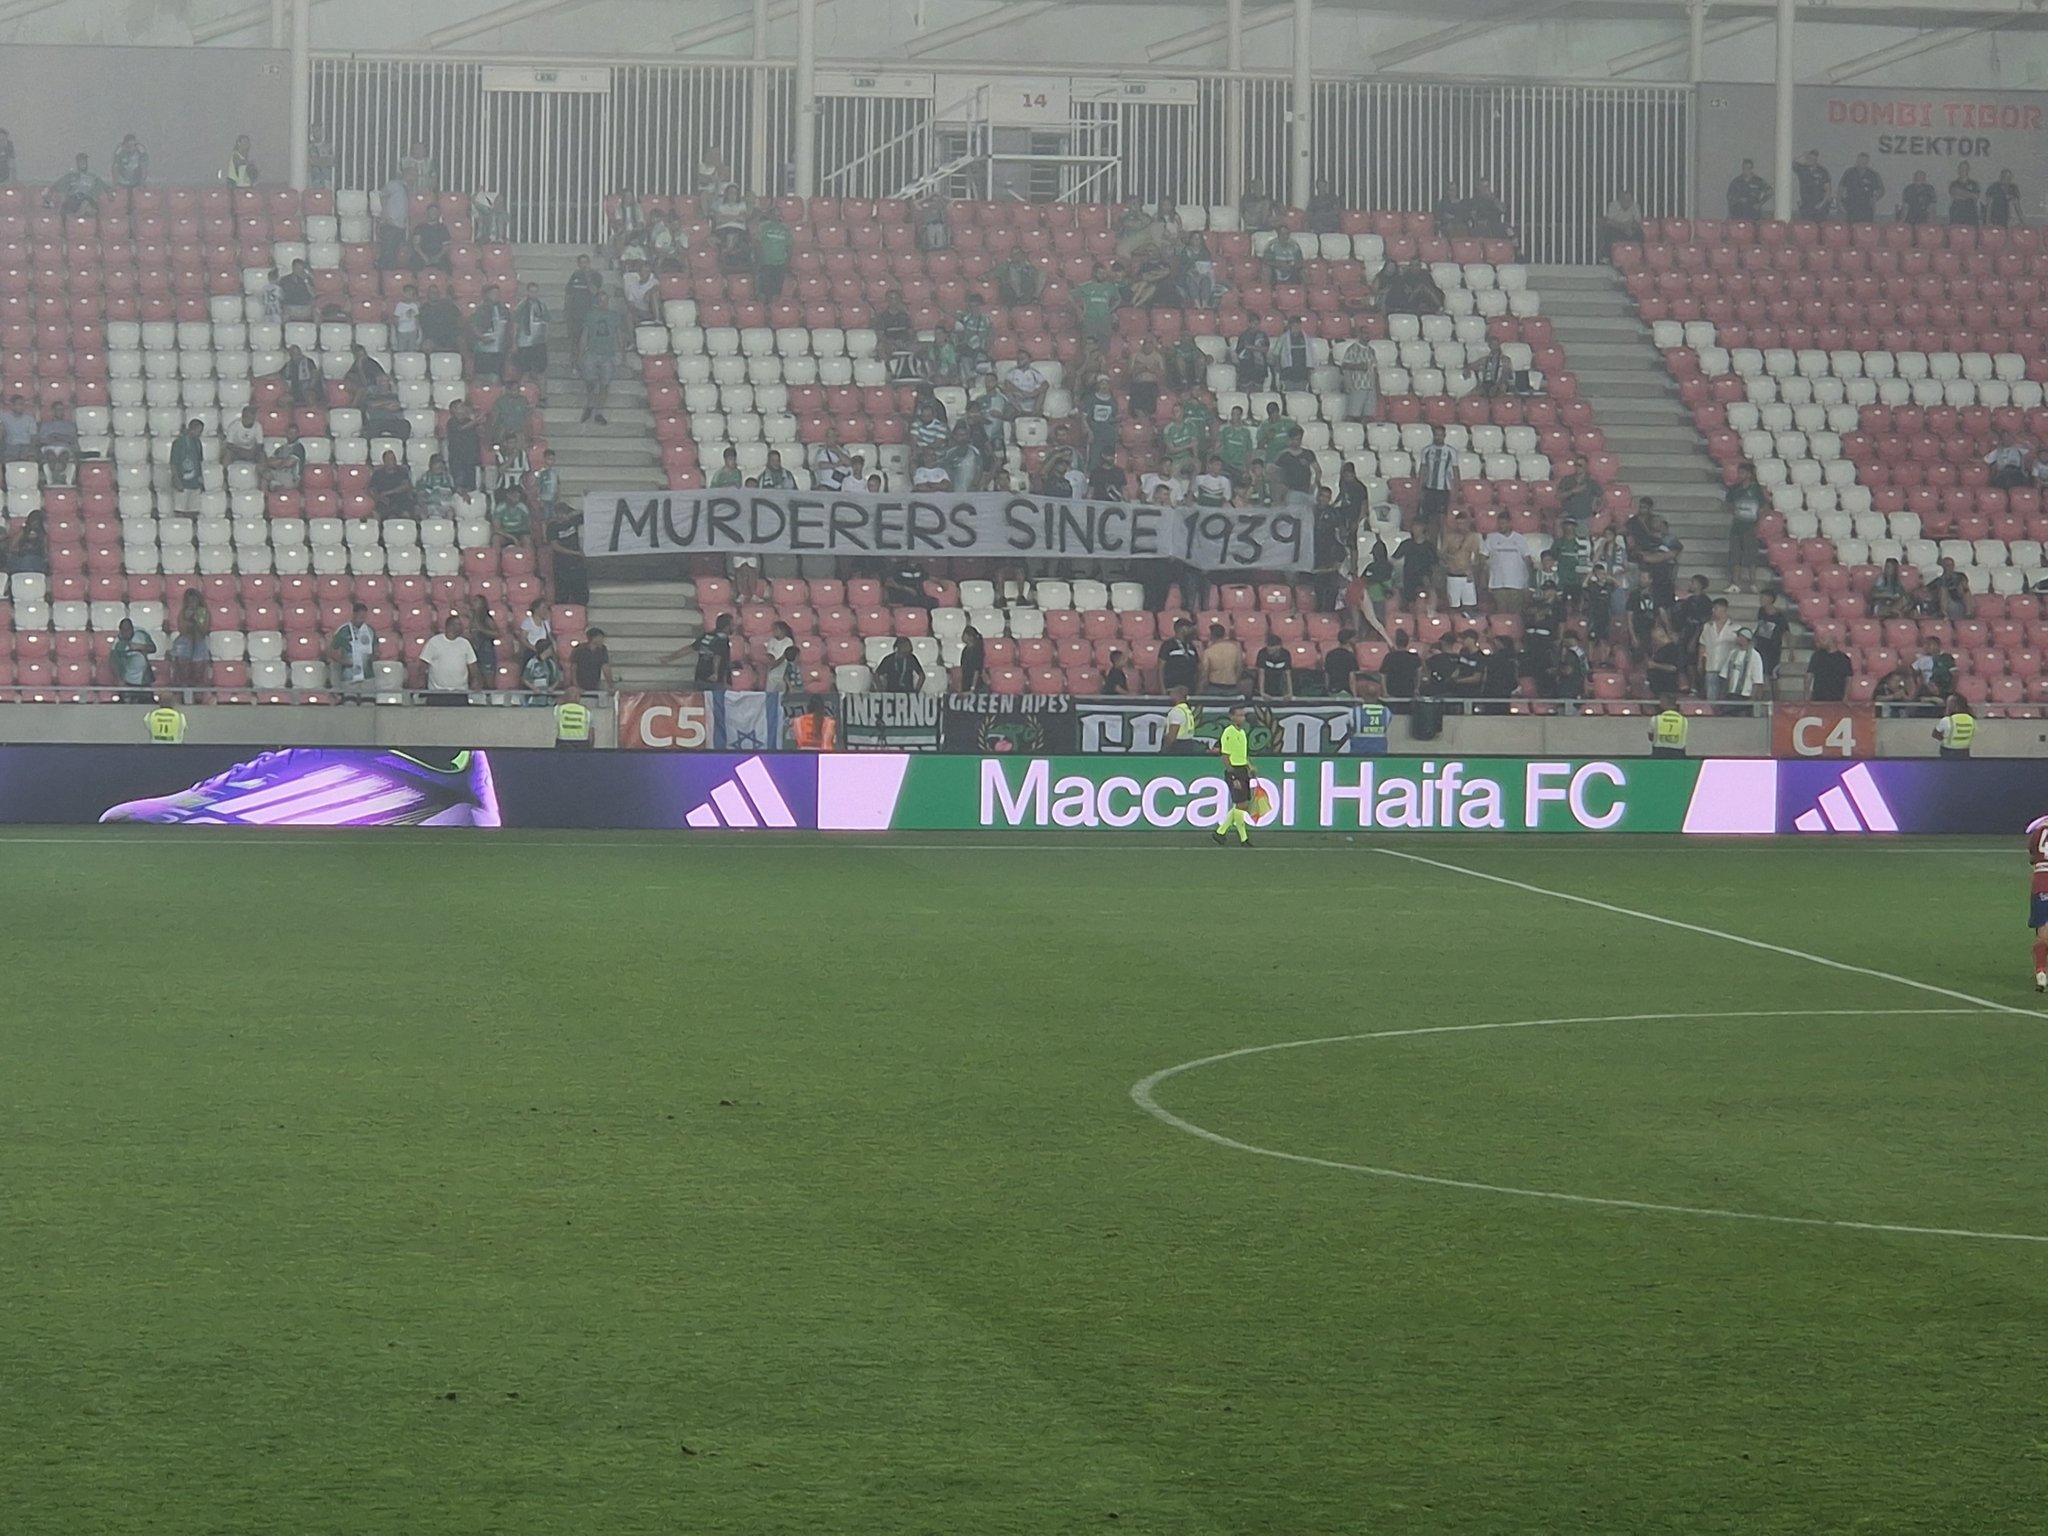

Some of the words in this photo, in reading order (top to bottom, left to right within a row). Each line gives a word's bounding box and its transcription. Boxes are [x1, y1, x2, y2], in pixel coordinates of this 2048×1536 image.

[1022, 93, 1048, 108] 14
[1827, 100, 1933, 128] DOMBI
[1943, 103, 2043, 129] TIBOR
[1878, 134, 1991, 157] SZEKTOR
[608, 497, 977, 552] MURDERERS
[1004, 499, 1162, 555] SINCE
[1184, 511, 1303, 565] 1939
[846, 692, 938, 727] INFERNO
[949, 693, 1014, 714] GREEN
[1021, 692, 1070, 714] APES
[640, 705, 707, 748] C5
[1792, 717, 1857, 757] C4
[1319, 760, 1505, 829] Haifa
[1525, 761, 1627, 830] FC
